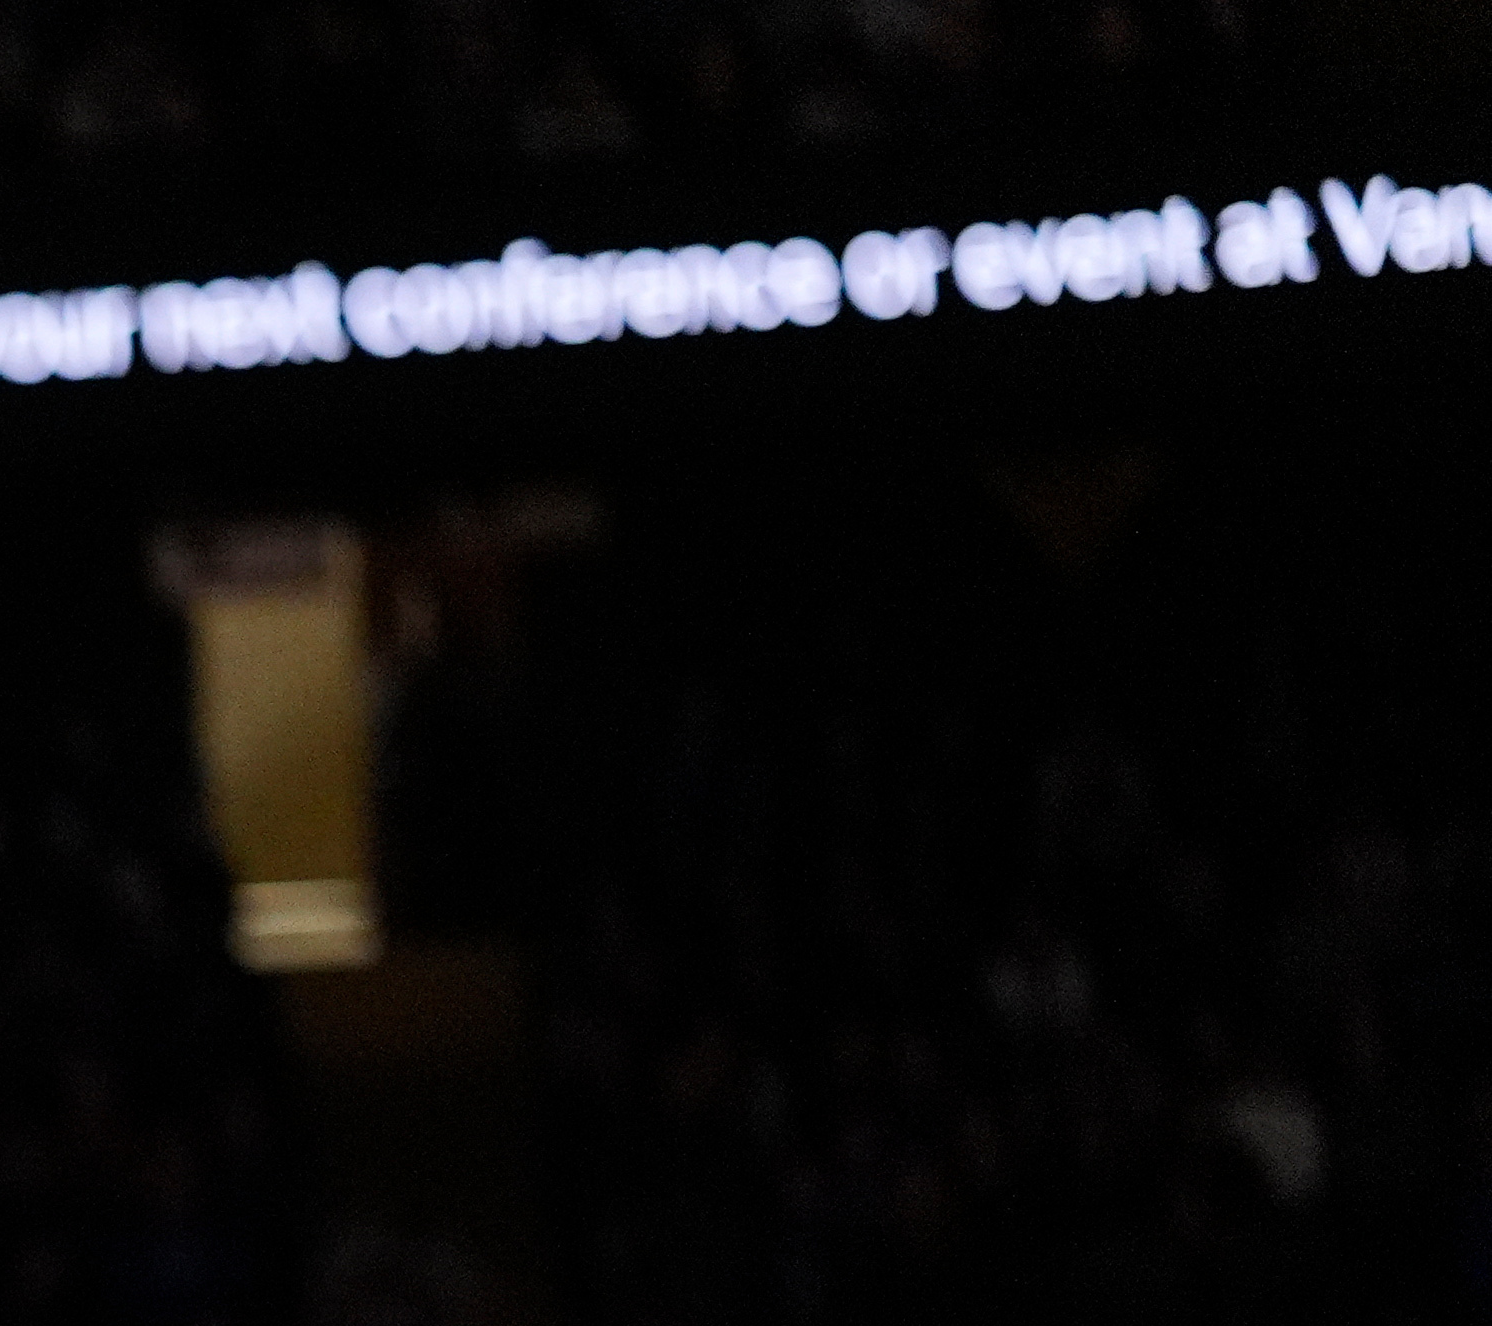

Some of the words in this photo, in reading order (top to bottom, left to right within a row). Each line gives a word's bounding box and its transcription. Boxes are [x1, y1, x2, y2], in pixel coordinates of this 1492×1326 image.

[138, 262, 345, 371] next
[344, 237, 841, 358] conference
[842, 227, 949, 319] or
[952, 196, 1212, 310] event
[1215, 187, 1318, 288] at
